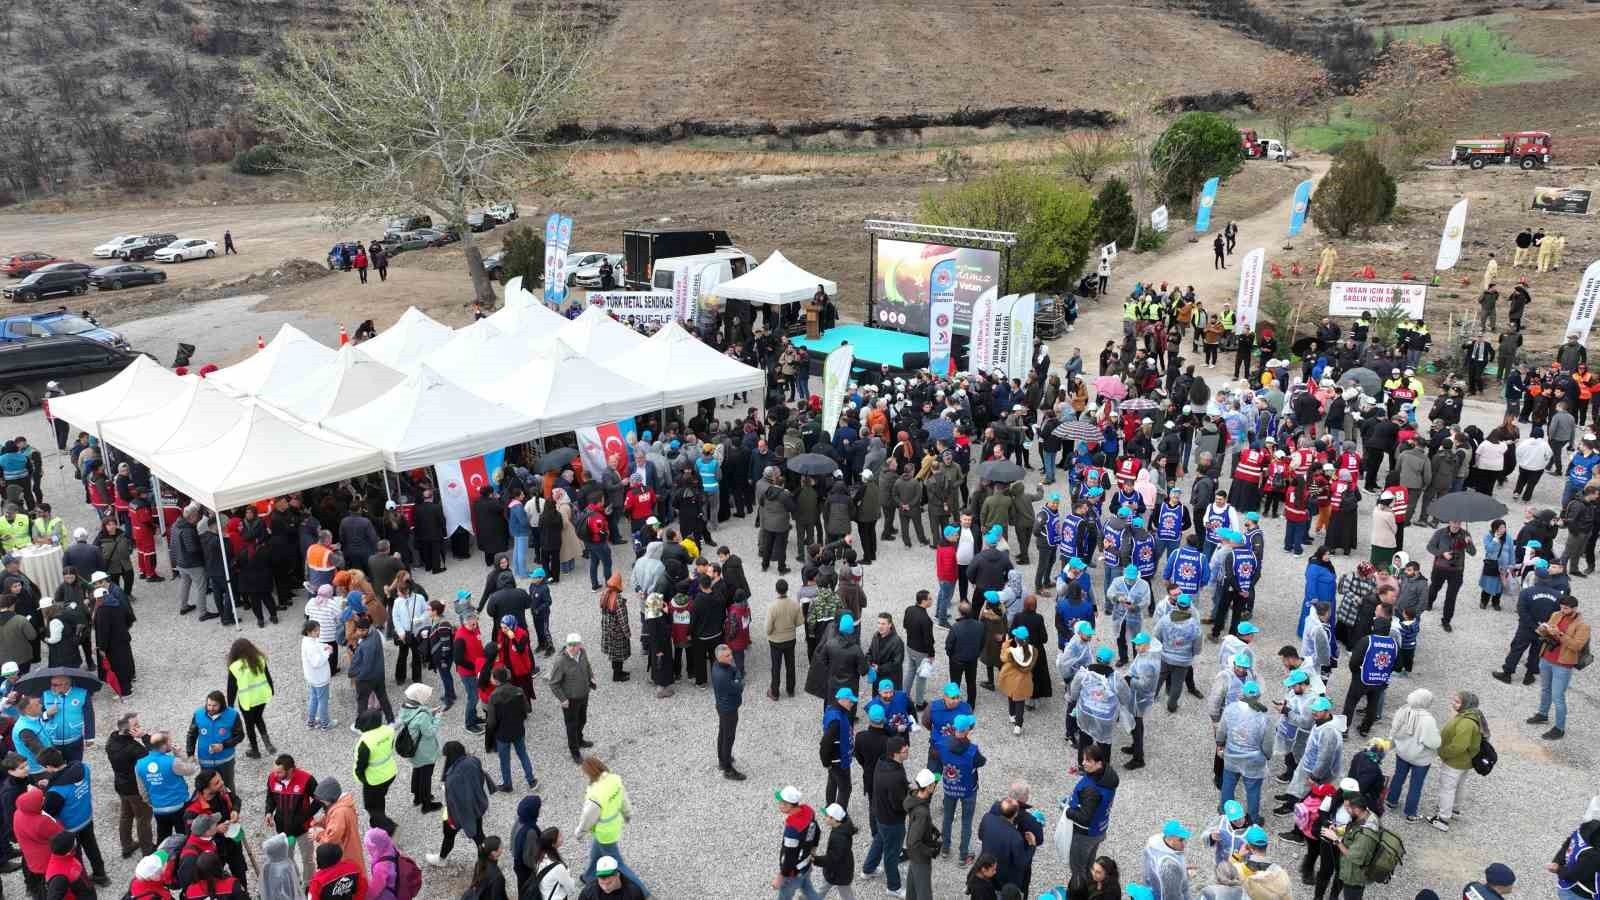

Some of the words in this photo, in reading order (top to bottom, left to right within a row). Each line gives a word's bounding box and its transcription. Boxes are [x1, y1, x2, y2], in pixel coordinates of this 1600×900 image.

[1345, 286, 1368, 294] İNSAN
[606, 294, 623, 309] TÜRK
[623, 295, 643, 309] METAL
[644, 295, 673, 309] SENDİKAS
[994, 312, 1002, 337] GENEL
[992, 338, 1000, 366] ORMAN
